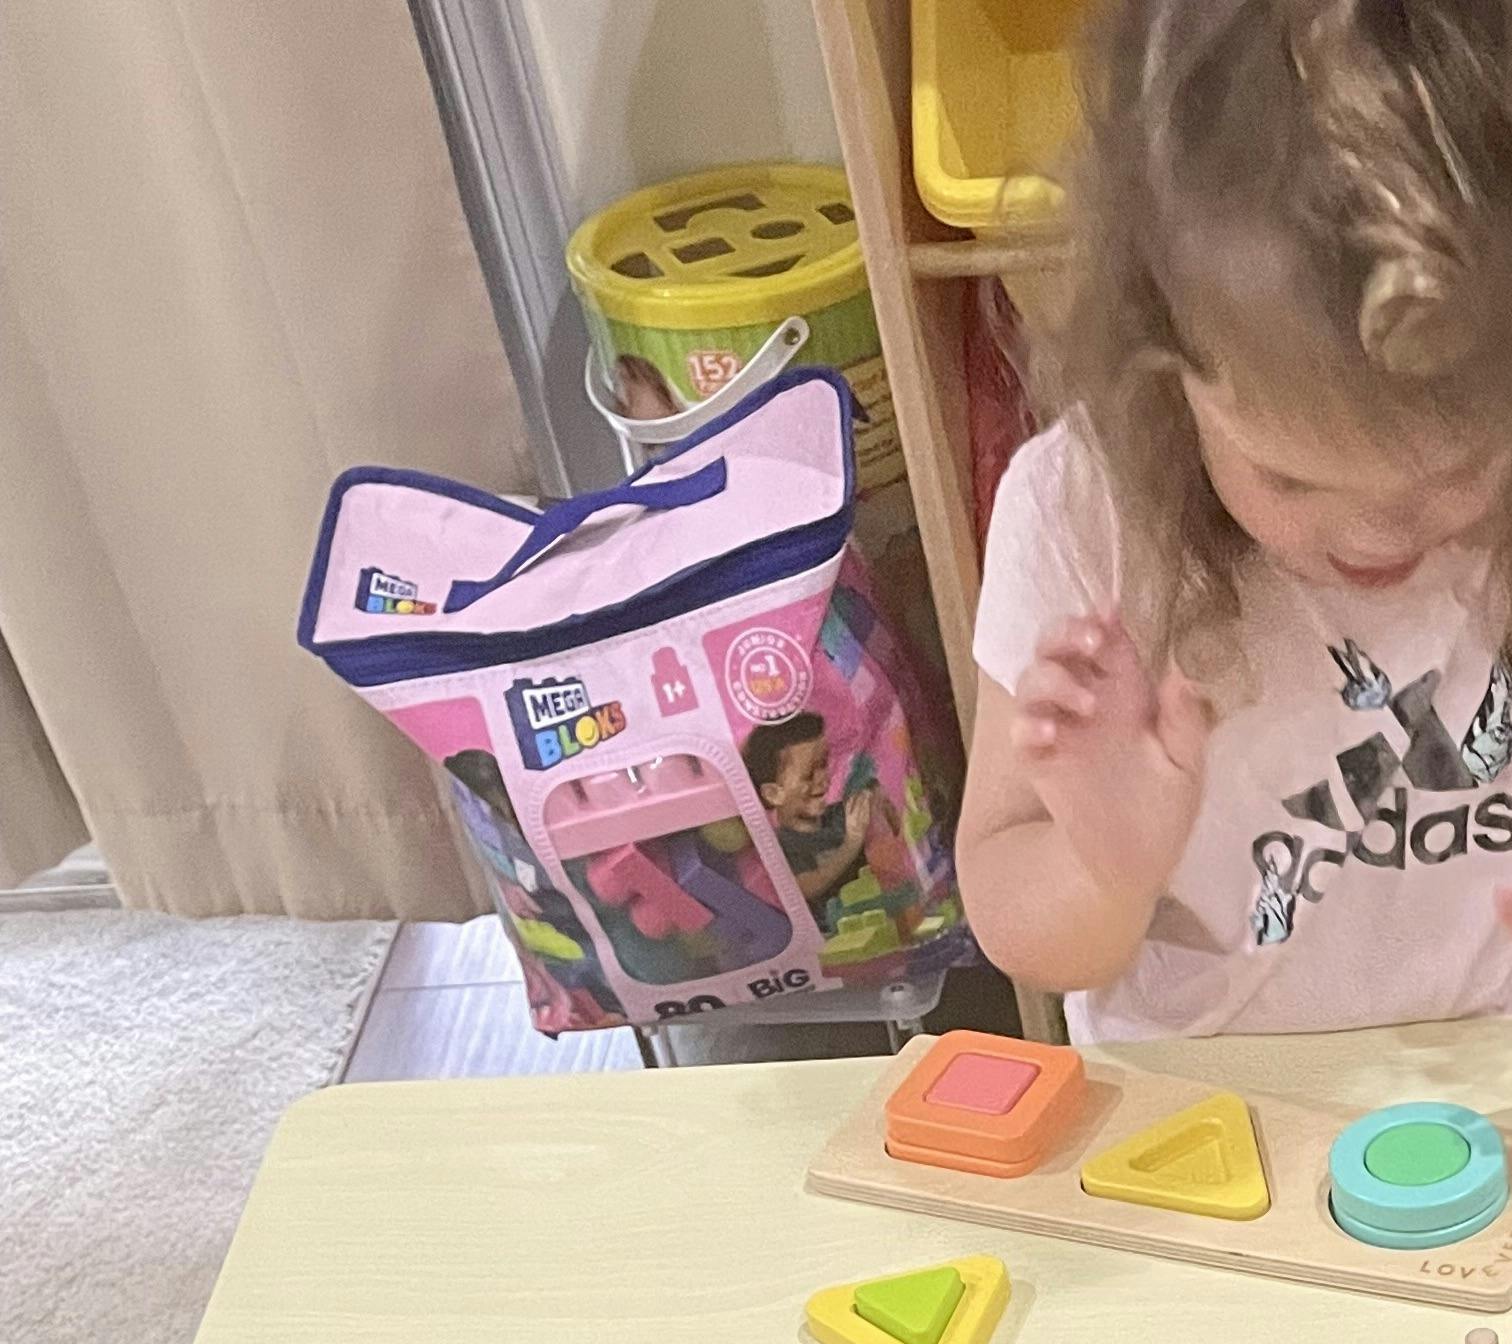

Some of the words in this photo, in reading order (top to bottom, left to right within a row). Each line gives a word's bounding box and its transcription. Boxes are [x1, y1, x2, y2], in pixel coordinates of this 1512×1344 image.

[374, 577, 413, 597] MEGA
[366, 594, 437, 615] BLOKS
[661, 680, 687, 704] 1+
[529, 687, 586, 723] MEGA
[534, 700, 627, 767] BLOKS
